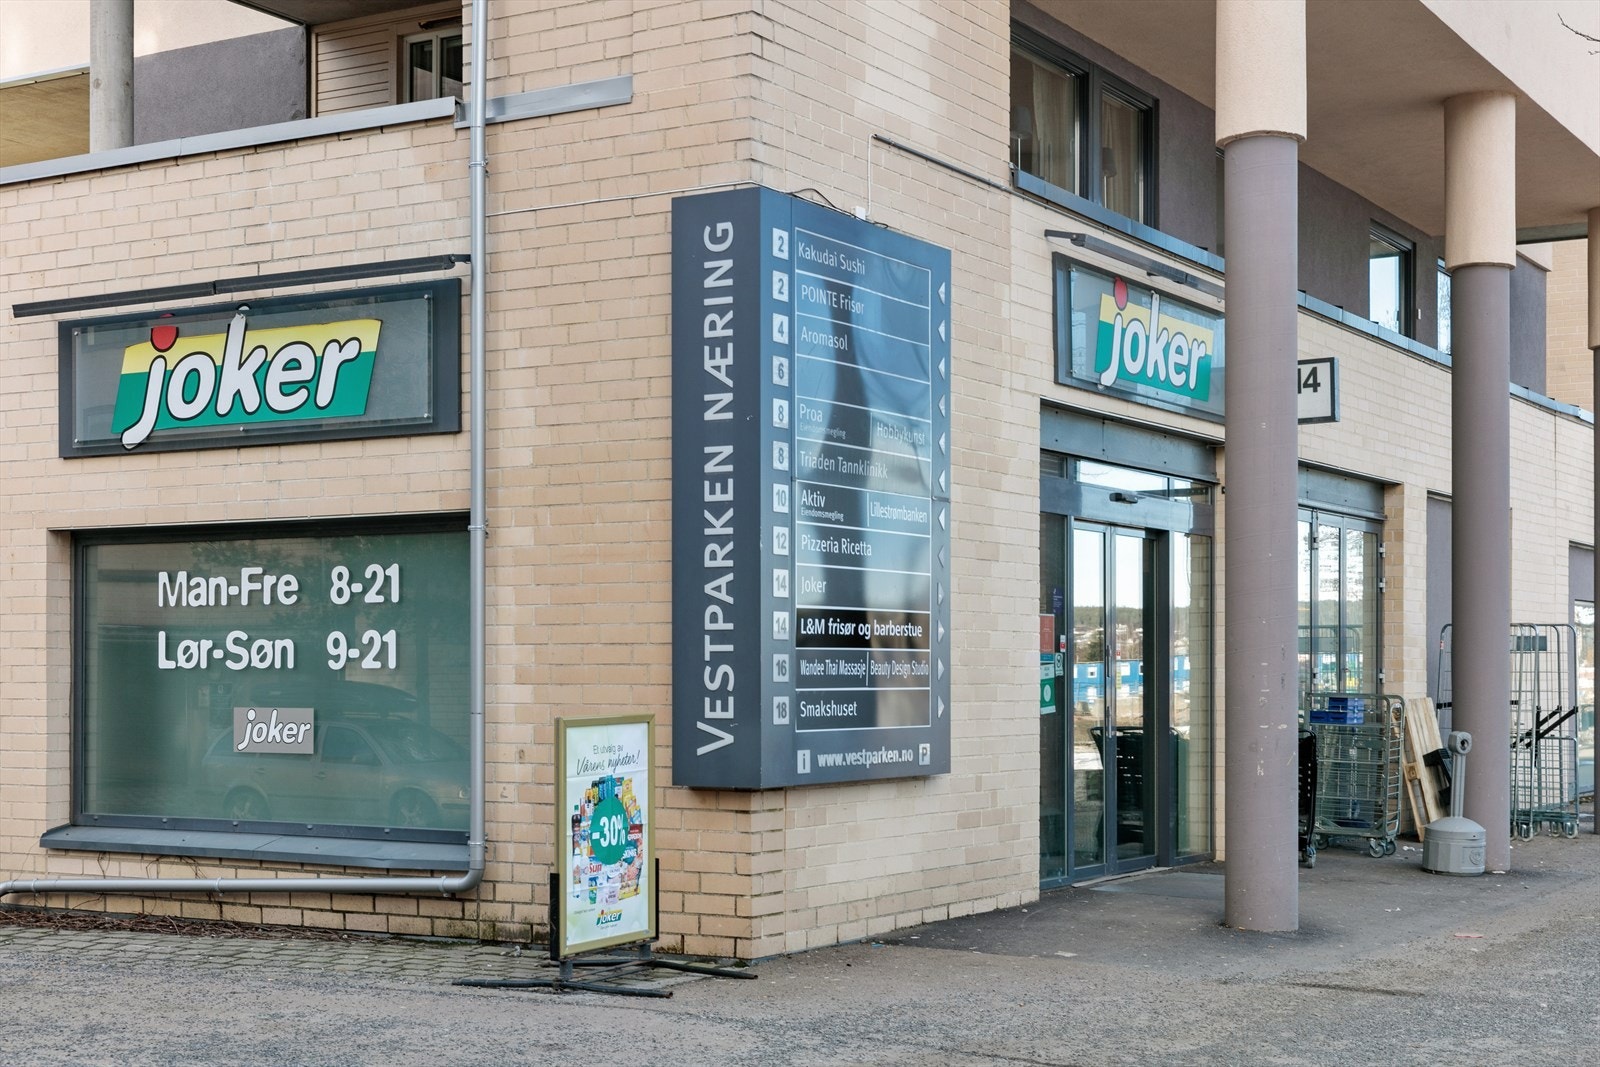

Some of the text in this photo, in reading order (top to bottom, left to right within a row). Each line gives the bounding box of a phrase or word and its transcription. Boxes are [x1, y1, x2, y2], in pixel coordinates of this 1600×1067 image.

[777, 235, 785, 253] 2
[798, 242, 865, 275] Kakudai Sushi
[777, 277, 785, 295] 2
[801, 284, 865, 315] POINTE Frisør
[777, 320, 785, 338] 4
[1100, 276, 1207, 390] joker
[801, 329, 848, 351] Aromasol
[121, 303, 362, 451] joker
[777, 362, 785, 380] 6
[777, 404, 785, 422] 8
[800, 404, 823, 422] Proa
[877, 422, 925, 446] Hobbykunst
[777, 447, 785, 464] 8
[800, 451, 888, 480] Triaden Tannklinikk
[696, 221, 735, 757] VESTPARKEN NÆRING
[775, 489, 787, 507] 10
[801, 489, 826, 508] Aktiv
[870, 501, 928, 524] Lillestrømbanken
[775, 532, 787, 550] 12
[801, 534, 872, 556] Pizzeria Ricetta
[158, 563, 400, 607] Man-Fre 8-21
[775, 575, 787, 592] 14
[801, 577, 827, 594] Joker
[775, 617, 787, 634] 14
[800, 617, 922, 640] L&M frisør og barberstue
[158, 629, 397, 671] Lør-Søn 9-21
[775, 660, 787, 677] 16
[800, 659, 866, 679] Wandee Thai Massasje
[870, 659, 929, 678] Beauty Design Studio
[775, 702, 787, 719] 18
[800, 701, 858, 718] Smakshuset
[237, 708, 311, 751] joker
[576, 750, 640, 775] Vårens nyheter!
[817, 747, 914, 769] www.vestparken.no
[592, 814, 626, 847] -30%
[597, 909, 622, 926] joker
